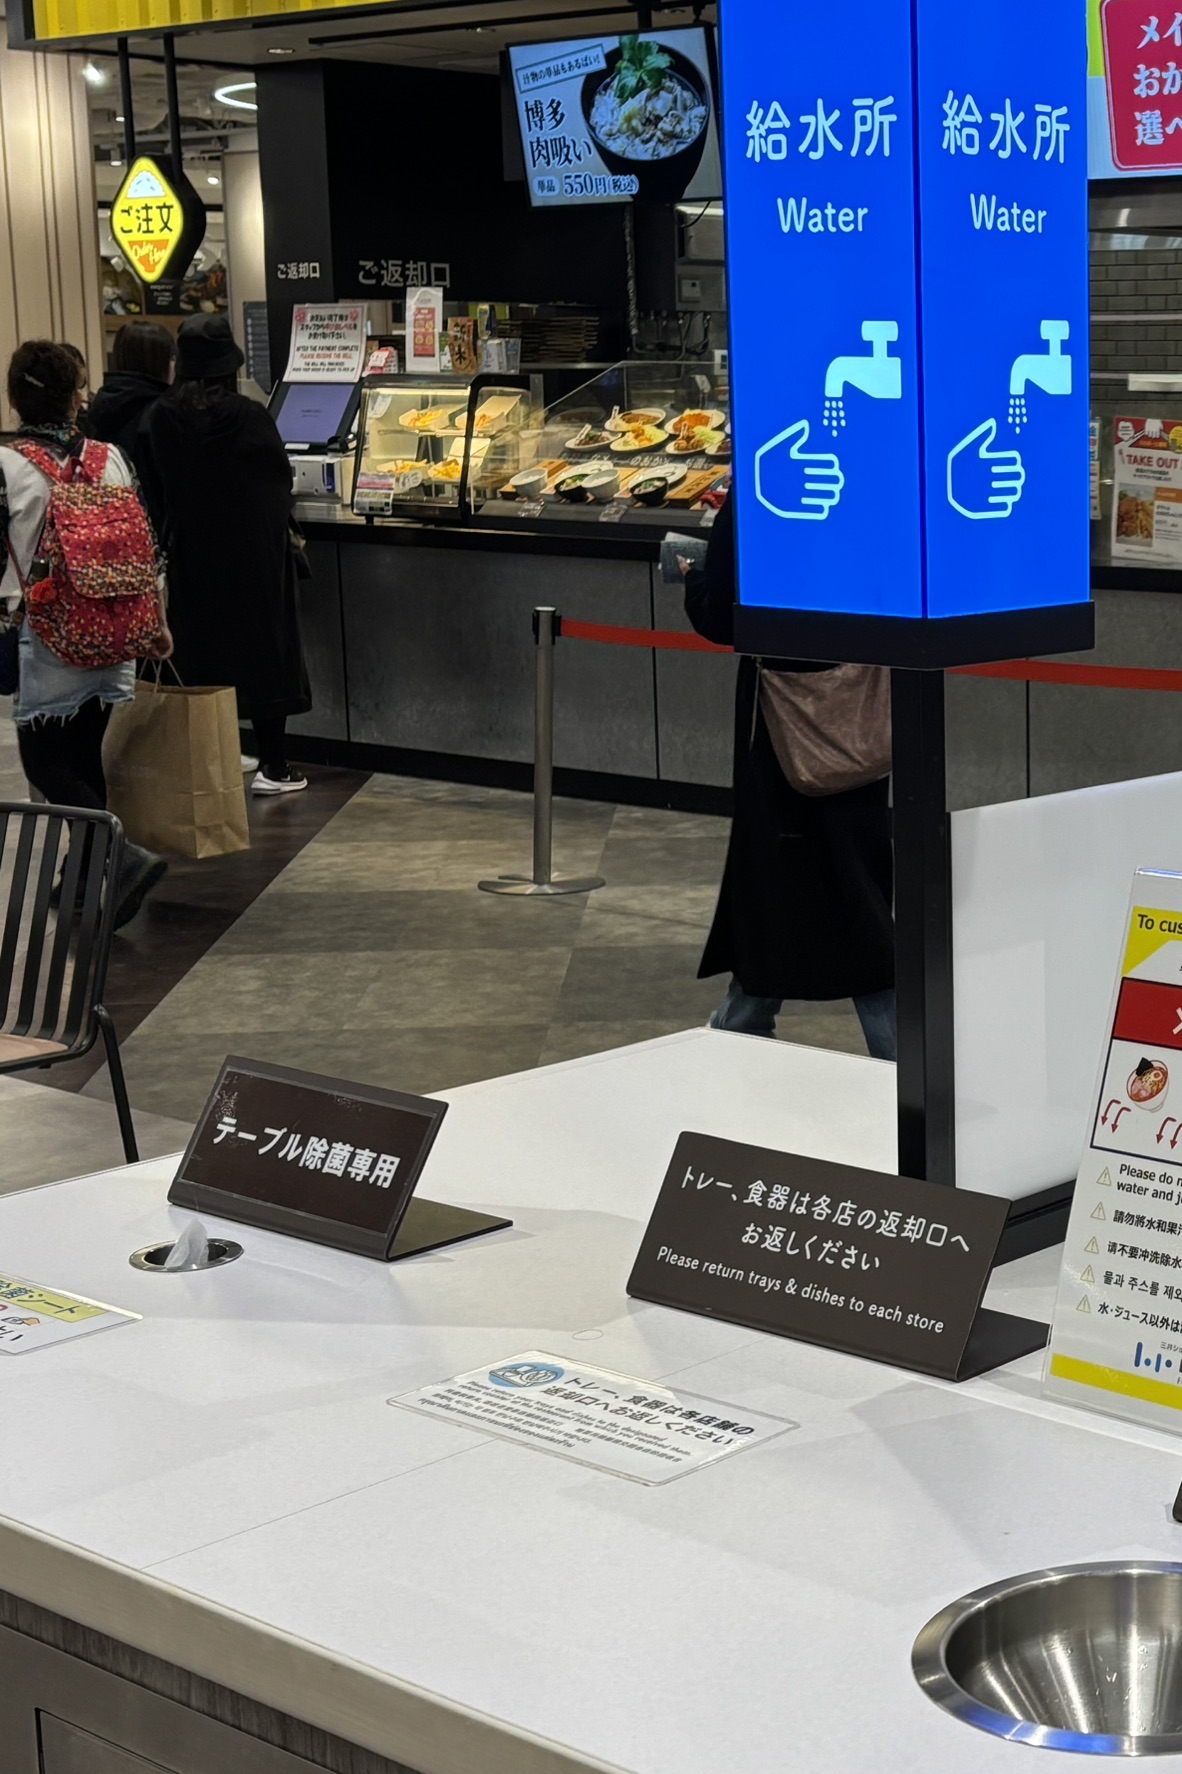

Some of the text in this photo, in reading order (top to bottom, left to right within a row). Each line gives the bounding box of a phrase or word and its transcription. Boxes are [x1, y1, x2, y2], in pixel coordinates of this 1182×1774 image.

[524, 98, 566, 133] 博多
[746, 95, 898, 163] 給水所
[942, 89, 1071, 164] 給水所
[529, 135, 593, 169] 肉吸い
[119, 203, 175, 235] ご注文
[777, 197, 868, 233] Water
[970, 193, 1047, 234] Water
[277, 262, 321, 280] ご返却口
[358, 259, 451, 289] ご返却口
[1126, 454, 1179, 469] TAKE OUT
[1137, 914, 1155, 931] To
[212, 1115, 402, 1190] テーブル除菌専用
[1116, 1181, 1150, 1196] water
[1151, 1189, 1174, 1202] and
[1119, 1163, 1156, 1182] Please
[1158, 1172, 1174, 1185] do
[680, 1164, 971, 1253] トレー、食器は各店の返却口へ
[740, 1222, 881, 1272] お返しください
[656, 1245, 945, 1334] Please return trays & dishes to each store
[1103, 1270, 1125, 1288] 물과
[1128, 1276, 1160, 1296] 주스를
[539, 1385, 735, 1446] 返却口へお返しください
[564, 1377, 755, 1435] トレー、食器は各店舗の
